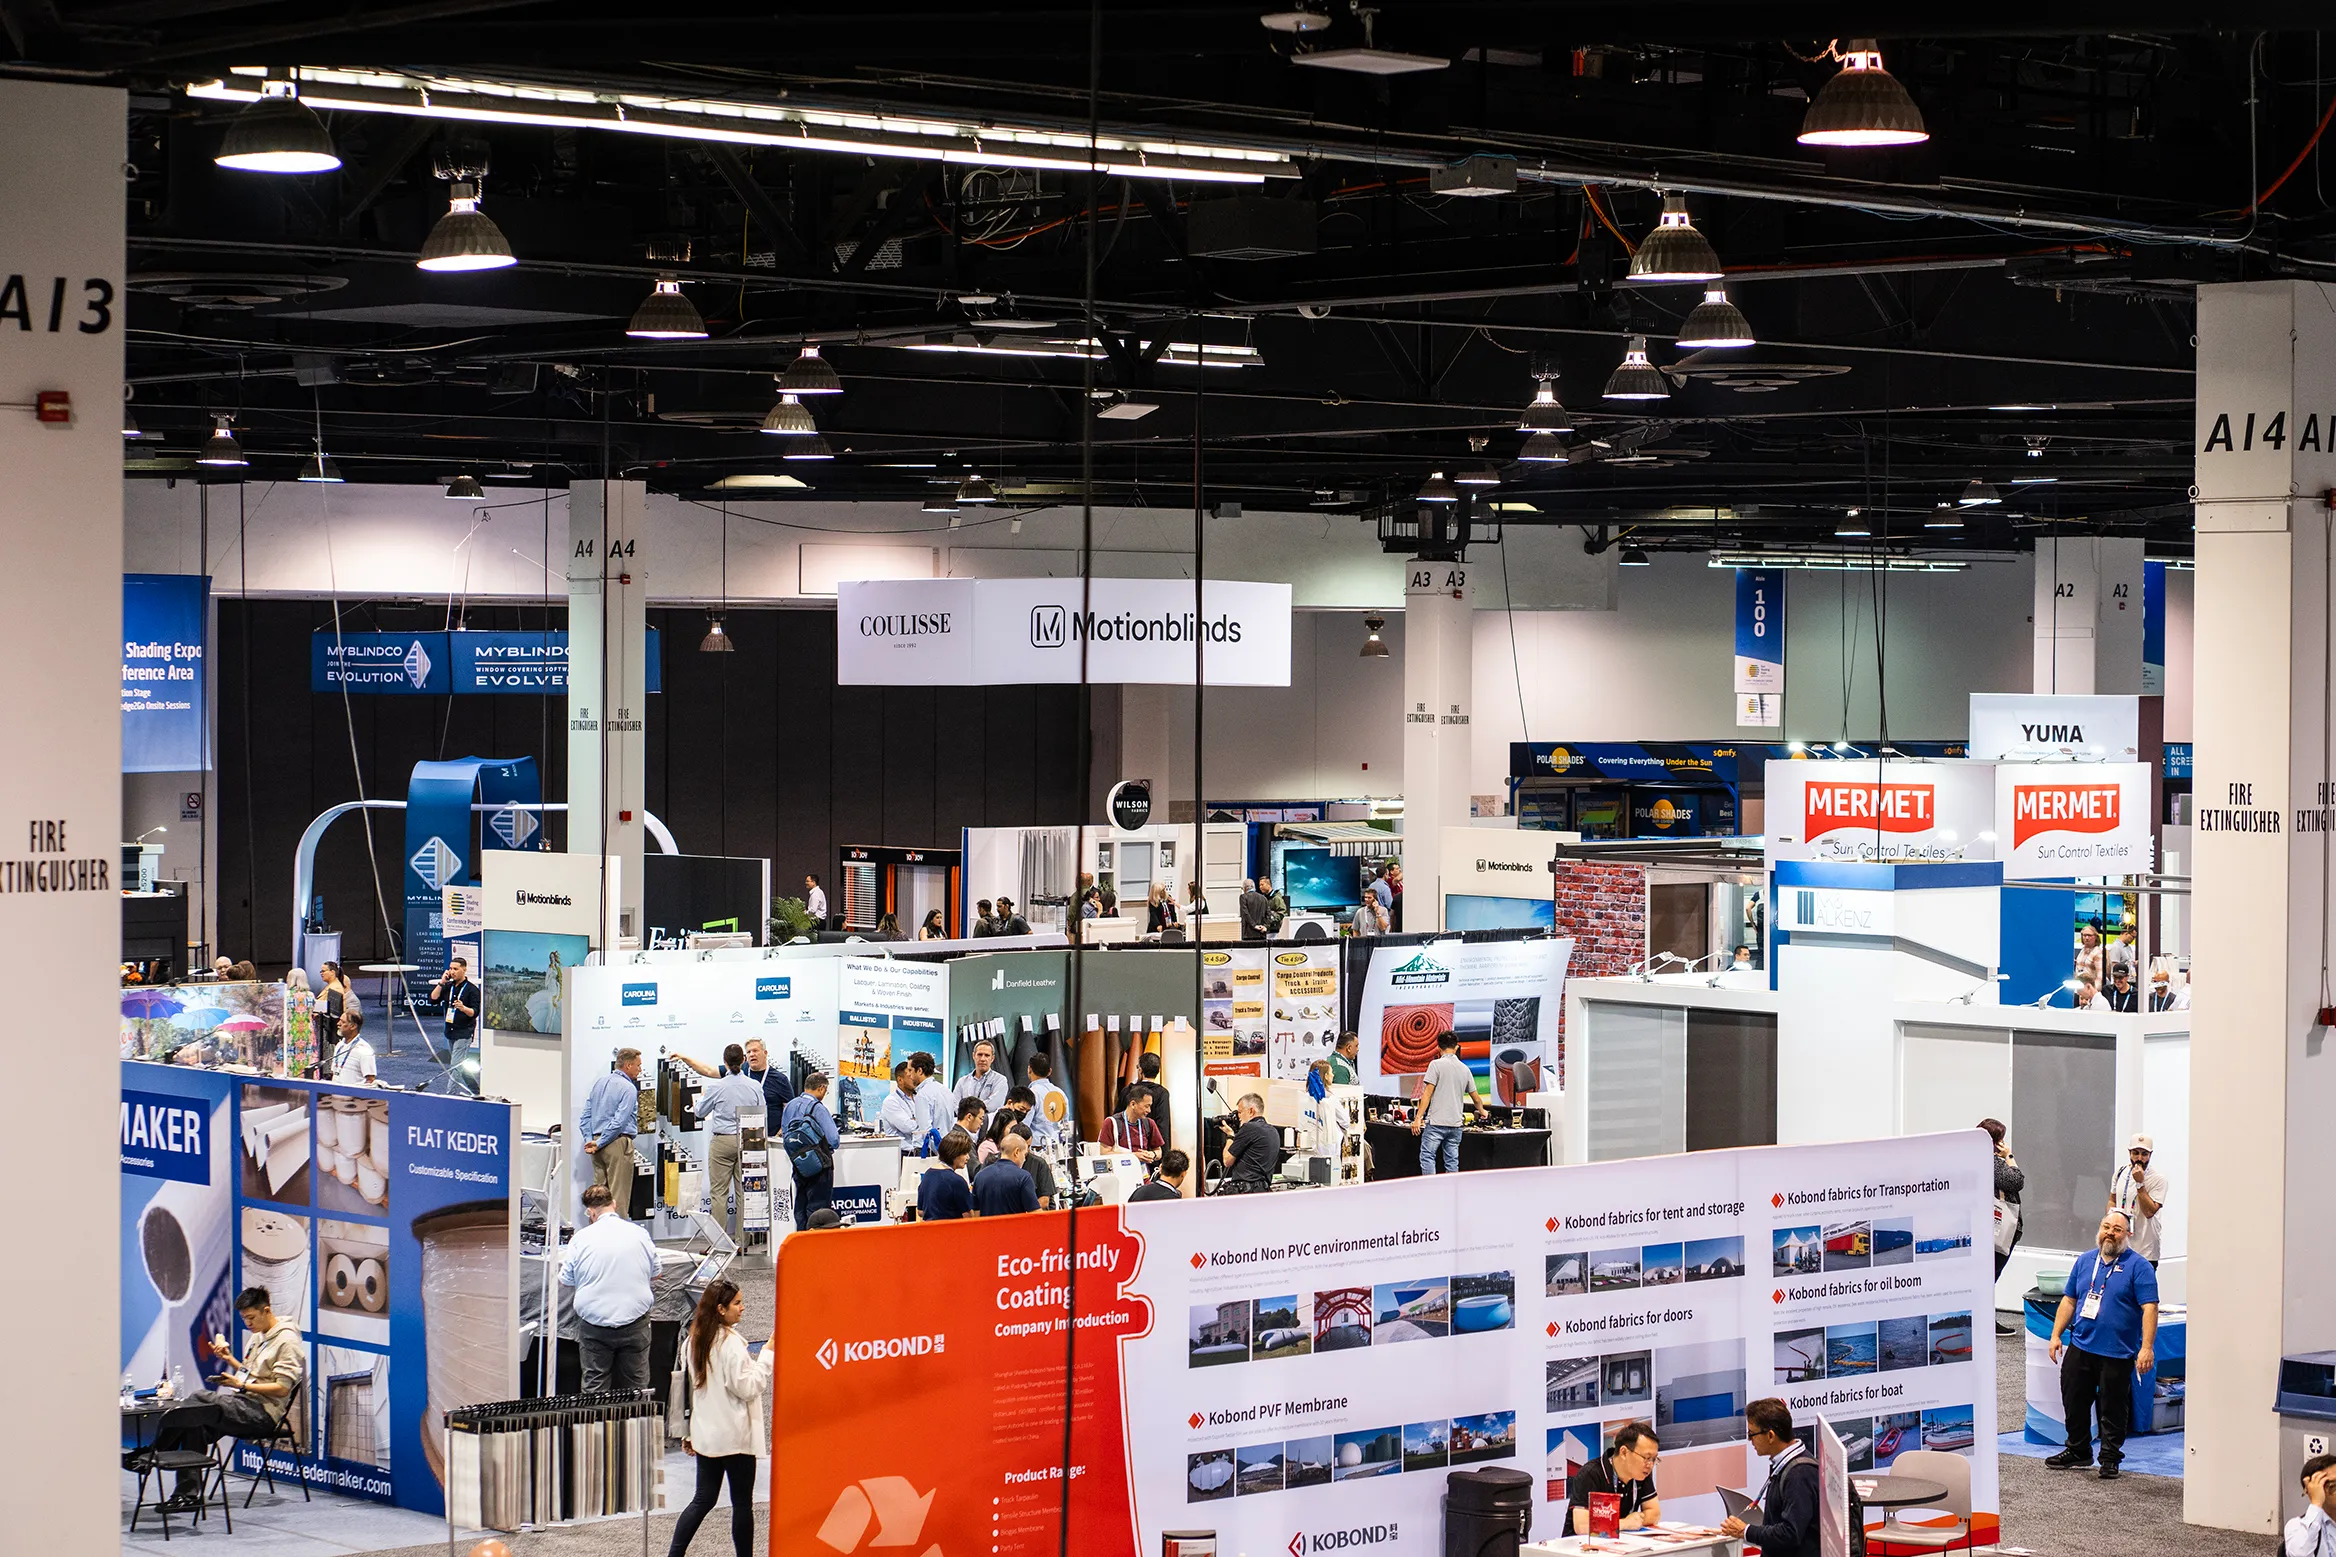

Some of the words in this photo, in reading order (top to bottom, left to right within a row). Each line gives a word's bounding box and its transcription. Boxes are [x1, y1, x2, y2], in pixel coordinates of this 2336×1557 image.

[575, 539, 594, 558] A4
[609, 539, 635, 558] A4
[1411, 571, 1432, 588] A3
[1446, 570, 1466, 587] A3
[2055, 583, 2074, 598] A2
[2113, 583, 2129, 598] A2
[860, 612, 951, 637] COULISSE
[1072, 611, 1242, 643] Motionblinds
[125, 642, 172, 661] Shading
[174, 642, 202, 661] Expo
[327, 646, 403, 657] MYBLINDCO
[167, 664, 194, 681] Area
[327, 671, 404, 682] EVOLUTION
[133, 689, 151, 699] Stage
[145, 701, 165, 711] Onsite
[165, 701, 191, 711] Sessions
[580, 708, 589, 718] FIRE
[1416, 703, 1426, 713] FIRE
[1450, 704, 1460, 714] FIRE
[571, 720, 598, 731] EXTINGUISHER
[1406, 713, 1436, 724] EXTINGUISHER
[1440, 715, 1470, 725] EXTINGUISHER
[2021, 724, 2084, 743] YUMA
[2170, 746, 2185, 756] ALL
[1537, 754, 1558, 764] POLAR
[1598, 756, 1628, 766] Covering
[1629, 757, 1665, 767] Everything
[1665, 758, 1686, 767] Under
[1687, 758, 1699, 767] the
[1699, 758, 1713, 767] Sun
[2171, 767, 2180, 776] IN
[2229, 783, 2252, 806] FIRE
[1115, 800, 1149, 809] WILSON
[1635, 808, 1660, 818] POLAR
[2200, 809, 2281, 833] EXTINGUISHER
[30, 820, 66, 853] FIRE
[1833, 841, 1854, 855] Sun
[2037, 845, 2055, 859] Sun
[2057, 845, 2093, 859] Control
[1488, 861, 1533, 872] Motionblinds
[527, 892, 572, 906] Motionblinds
[1815, 909, 1872, 929] ALKENZ
[846, 963, 862, 971] What
[874, 965, 883, 973] Do
[902, 967, 939, 977] Capabilities
[757, 984, 789, 992] CAROLINA
[1006, 979, 1032, 988] Danfield
[1033, 978, 1057, 987] Leather
[623, 990, 656, 999] CAROLINA
[849, 1015, 877, 1023] BALLISTIC
[902, 1020, 936, 1028] INDUSTRIAL
[408, 1126, 444, 1149] FLAT
[447, 1130, 499, 1156] KEDER
[408, 1163, 454, 1179] Customizable
[454, 1168, 498, 1185] Specification
[1787, 1188, 1826, 1205] Kobond
[1828, 1186, 1861, 1201] fabrics
[1862, 1184, 1878, 1198] for
[1879, 1178, 1950, 1197] Transportation
[840, 1208, 878, 1216] PERFORMANCE
[1564, 1212, 1606, 1230] Kobond
[1608, 1209, 1644, 1226] fabrics
[1645, 1207, 1661, 1221] for
[1663, 1206, 1685, 1219] tent
[1686, 1203, 1706, 1217] and
[1707, 1201, 1745, 1217] storage
[1210, 1247, 1258, 1267] Kobond
[1261, 1247, 1285, 1261] Non
[1288, 1242, 1311, 1258] PVC
[1313, 1231, 1399, 1256] environmental
[1401, 1228, 1440, 1245] fabrics
[997, 1243, 1120, 1278] Eco-friendly
[1788, 1283, 1827, 1301] Kobond
[1829, 1281, 1862, 1297] fabrics
[1864, 1279, 1879, 1293] for
[1880, 1276, 1892, 1290] oil
[1894, 1274, 1922, 1288] boom
[996, 1281, 1075, 1311] Coating
[994, 1318, 1053, 1338] Company
[1565, 1315, 1607, 1334] Kobond
[1608, 1312, 1645, 1329] fabrics
[1646, 1310, 1662, 1325] for
[1663, 1307, 1694, 1322] doors
[844, 1334, 933, 1363] KOBOND
[1789, 1393, 1828, 1410] Kobond
[1830, 1389, 1864, 1404] fabrics
[1865, 1386, 1880, 1400] for
[1881, 1383, 1904, 1398] boat
[1208, 1405, 1256, 1426] Kobond
[1259, 1403, 1282, 1419] PVF
[1285, 1396, 1348, 1416] Membrane
[1004, 1466, 1048, 1485] Product
[1312, 1525, 1388, 1552] KOBOND
